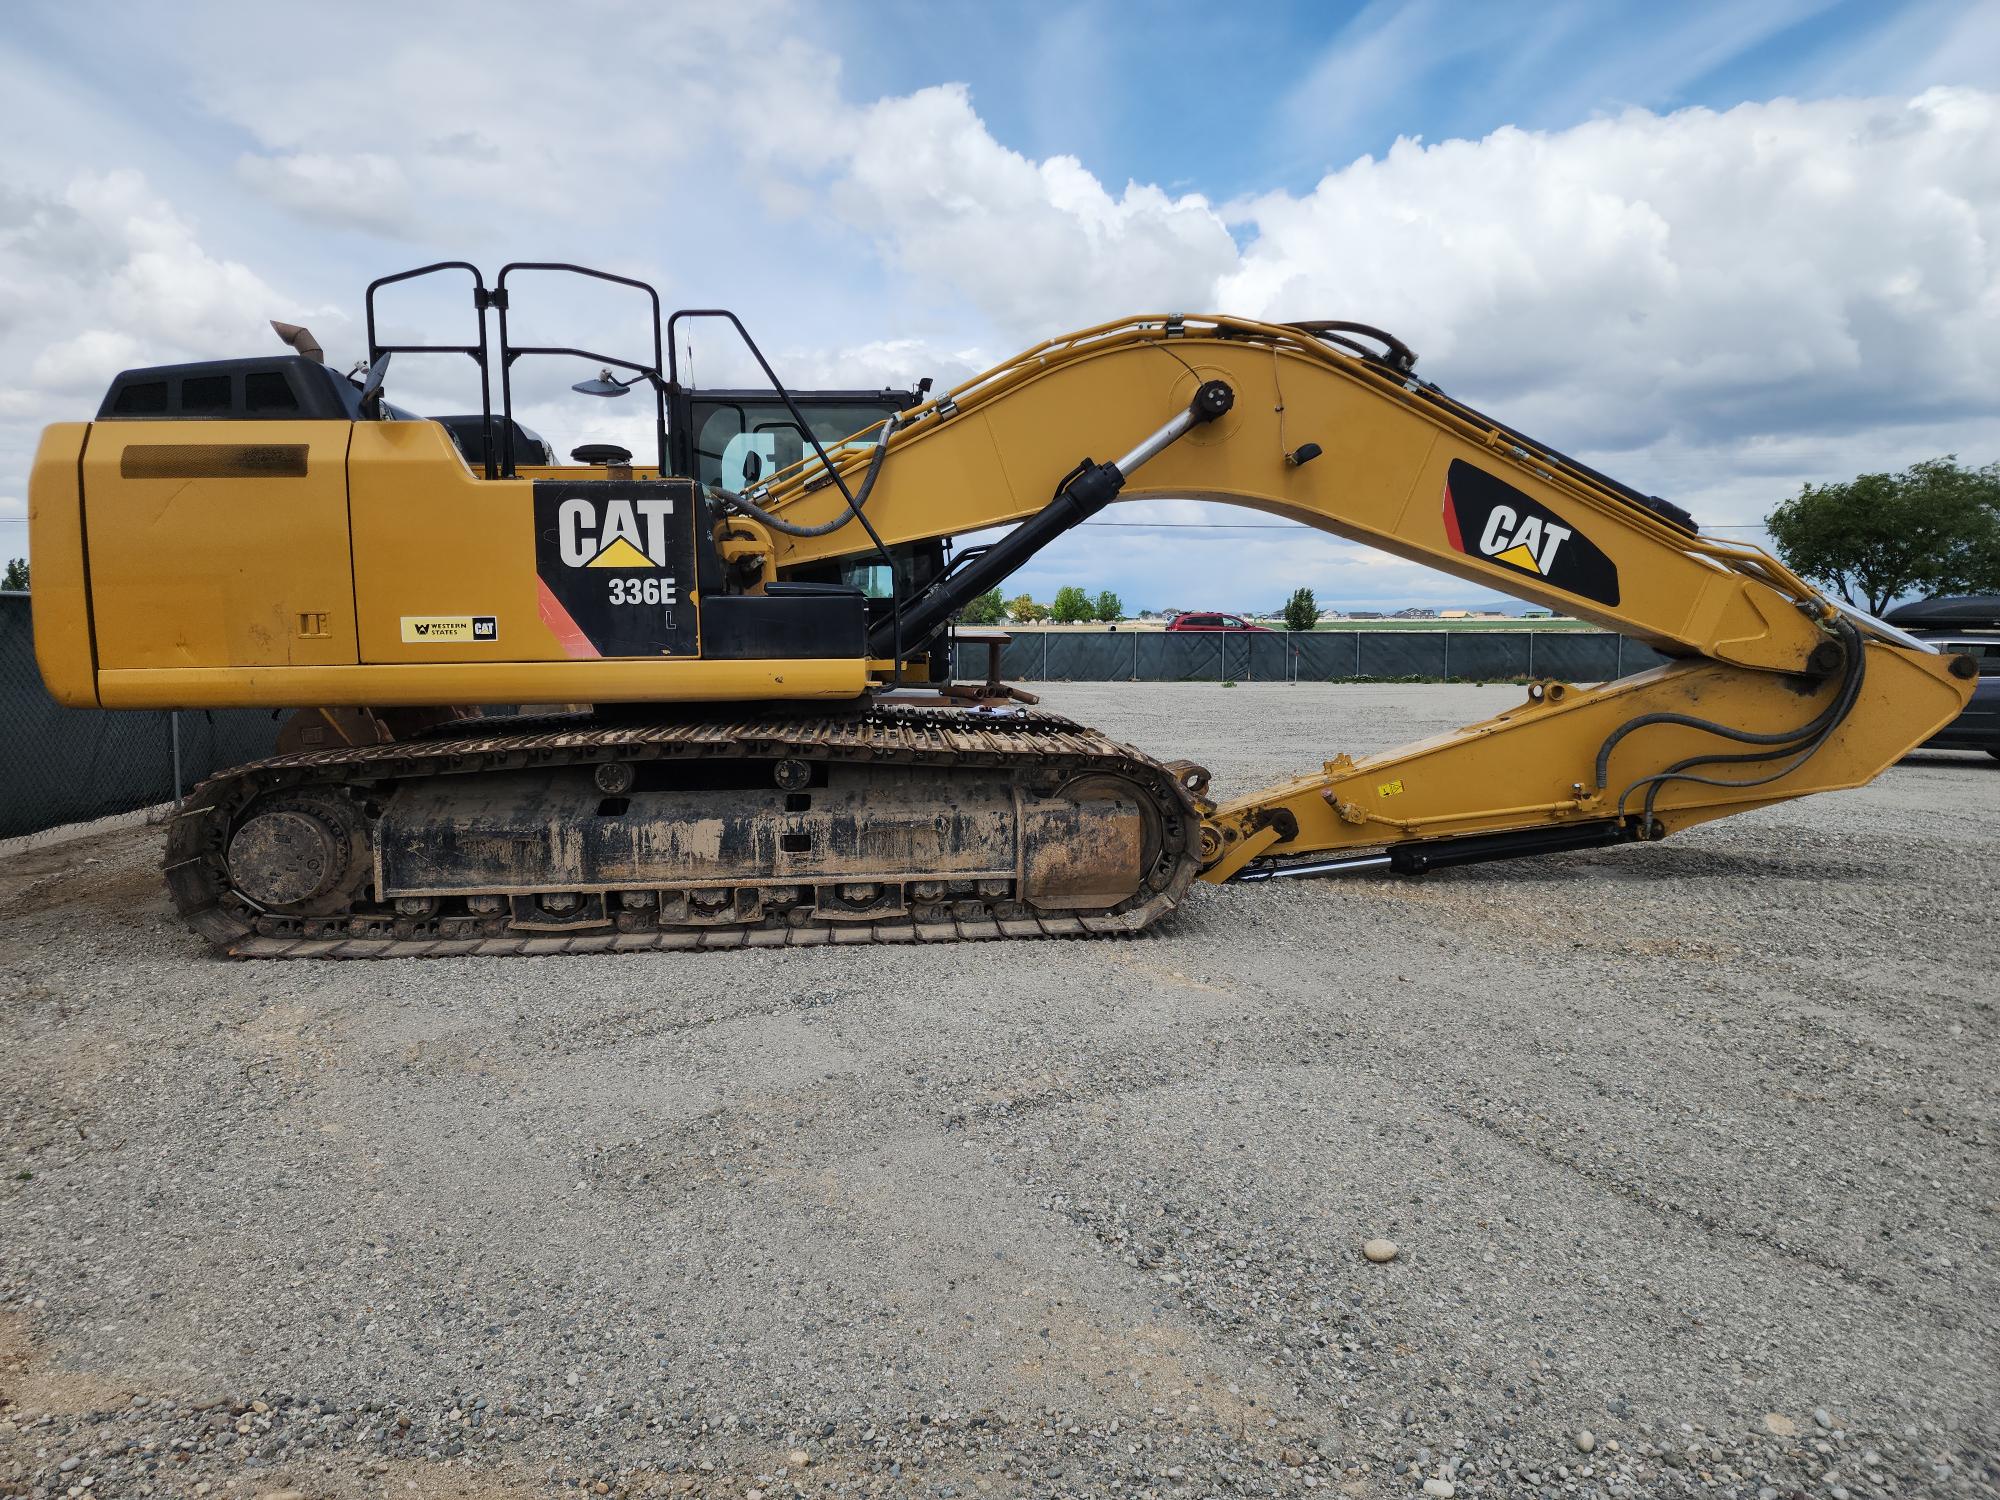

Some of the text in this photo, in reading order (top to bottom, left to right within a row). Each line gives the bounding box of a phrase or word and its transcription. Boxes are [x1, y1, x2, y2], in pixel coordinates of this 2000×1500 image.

[558, 499, 674, 568] CAT
[1479, 504, 1572, 577] CAT
[608, 578, 677, 605] 336E
[474, 622, 494, 635] CAT
[665, 610, 677, 630] L
